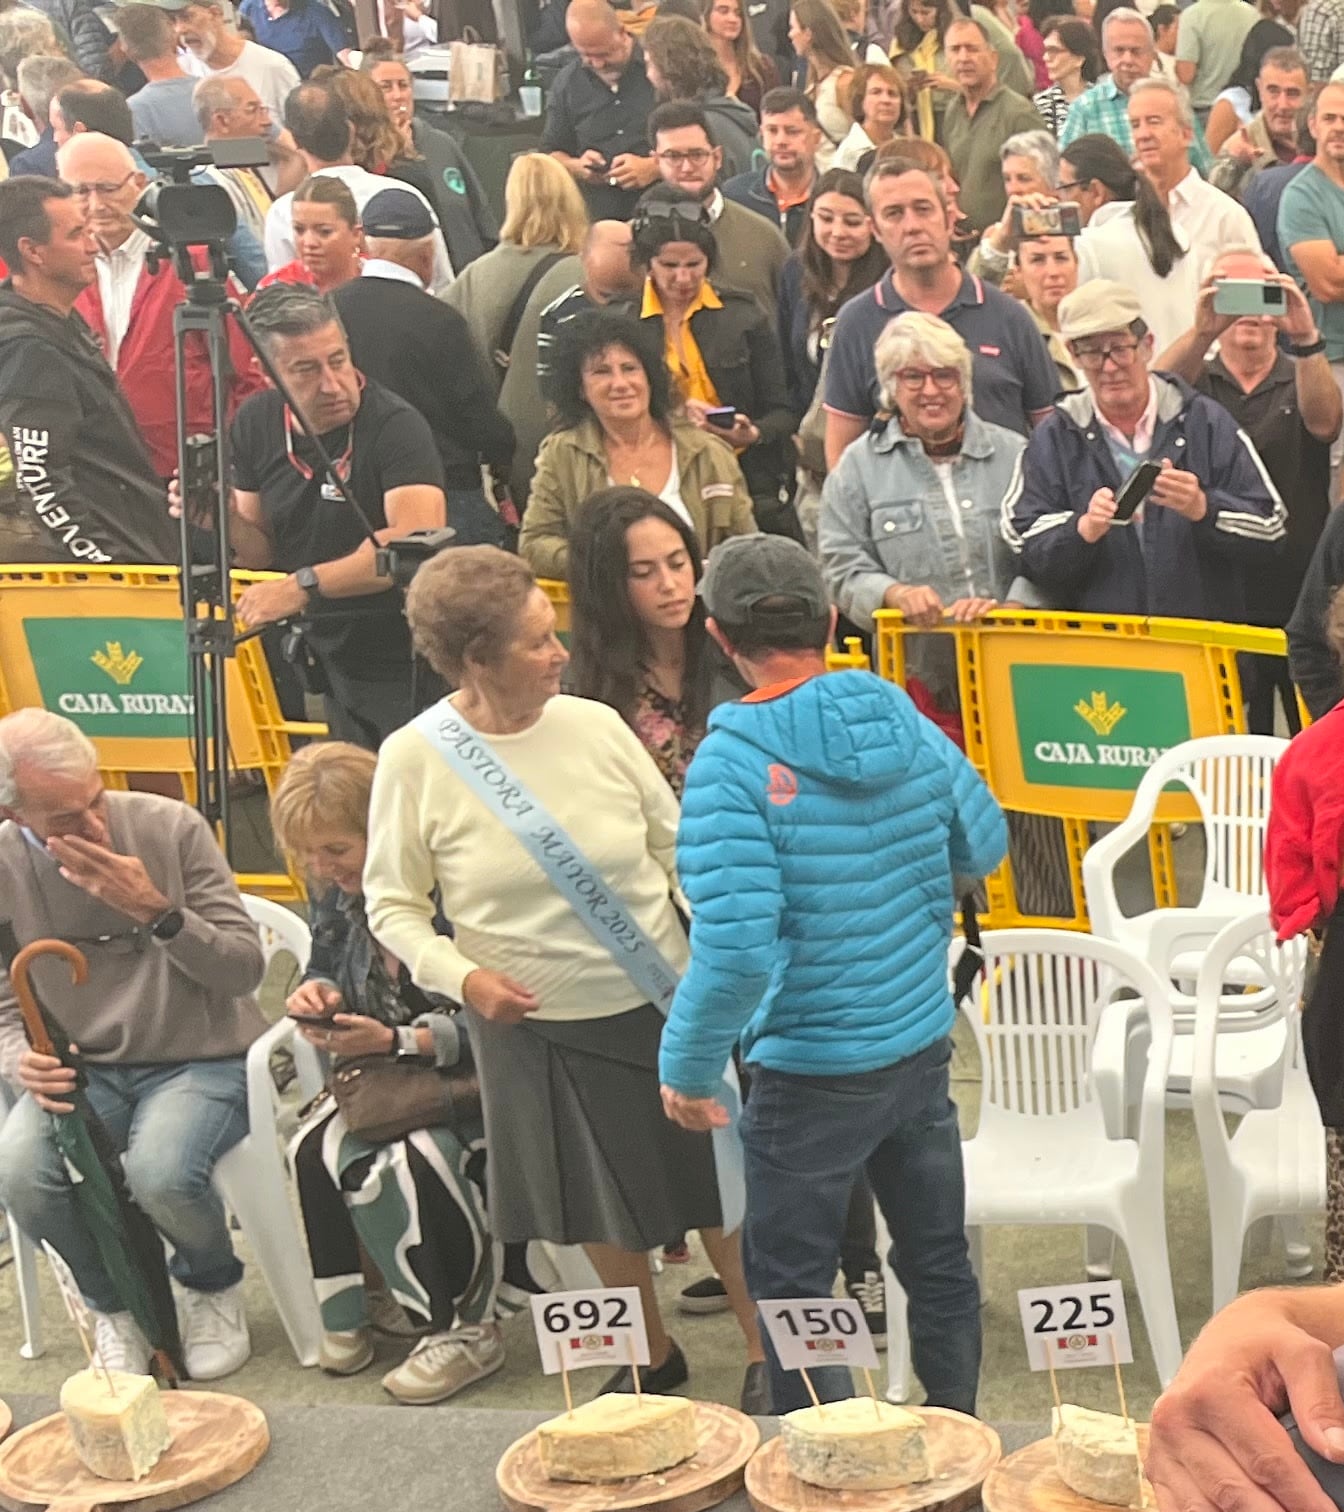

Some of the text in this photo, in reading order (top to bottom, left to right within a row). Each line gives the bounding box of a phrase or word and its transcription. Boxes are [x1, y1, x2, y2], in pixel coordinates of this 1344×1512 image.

[22, 427, 113, 563] ADVENTURE
[58, 693, 119, 715] CAJA
[1034, 741, 1168, 767] CAJA RURA
[438, 718, 648, 955] PASTORA MAYOR 2025
[543, 1297, 632, 1333] 692
[775, 1308, 858, 1336] 150
[1030, 1293, 1115, 1334] 225
